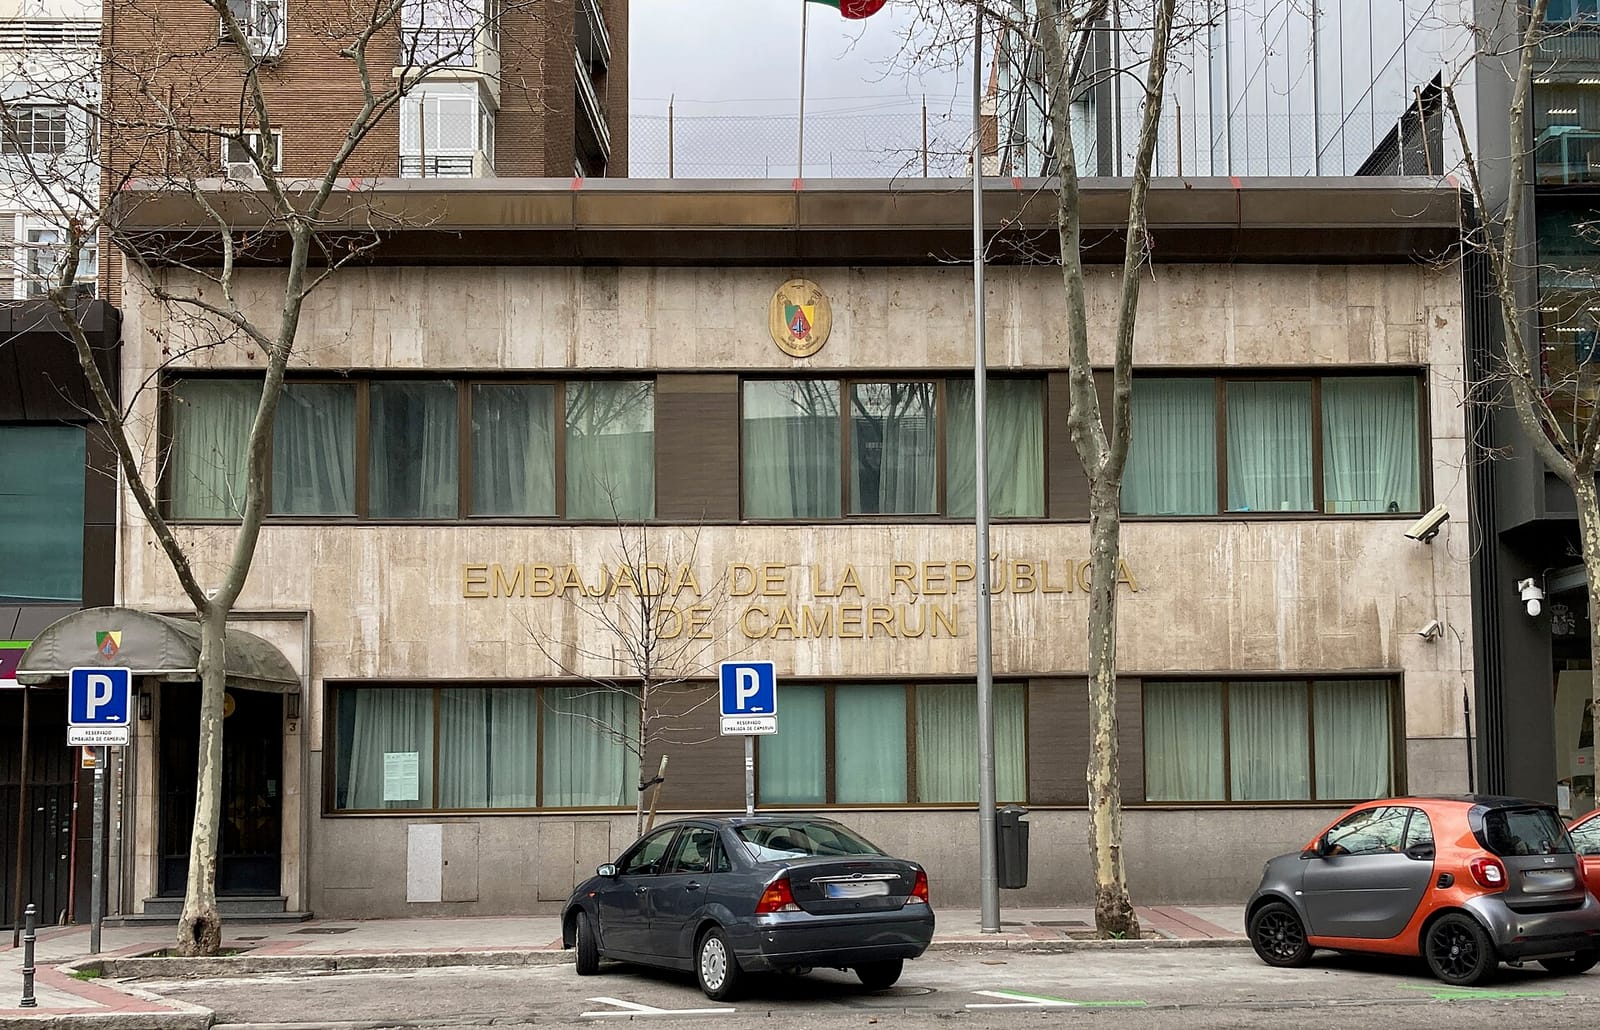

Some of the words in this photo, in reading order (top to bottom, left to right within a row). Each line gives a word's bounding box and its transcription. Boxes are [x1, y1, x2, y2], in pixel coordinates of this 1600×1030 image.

[462, 562, 702, 598] EMBAJADA
[729, 563, 787, 597] DE
[812, 562, 865, 597] LA
[656, 605, 714, 640] DE
[740, 596, 959, 639] CAMERÚN
[86, 674, 113, 719] P
[735, 667, 760, 710] P
[289, 722, 297, 732] 3
